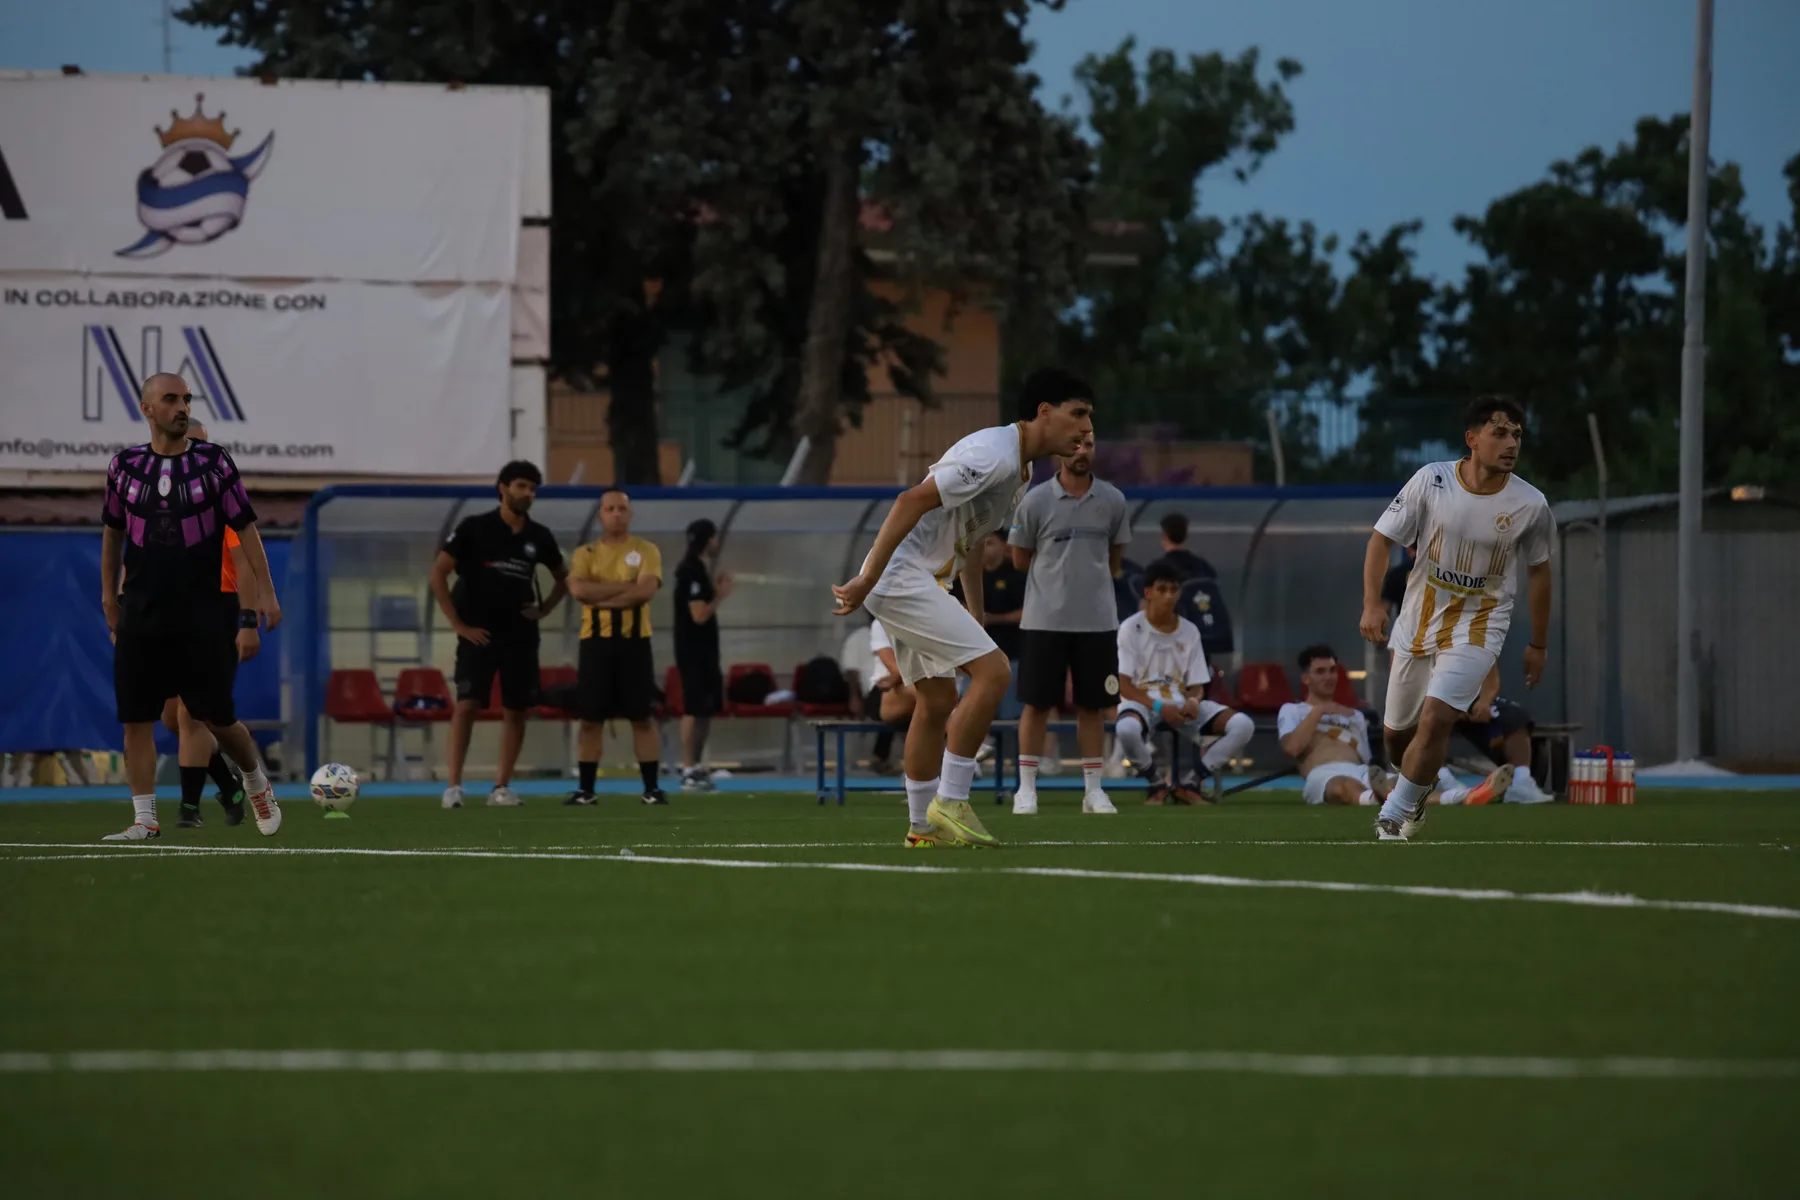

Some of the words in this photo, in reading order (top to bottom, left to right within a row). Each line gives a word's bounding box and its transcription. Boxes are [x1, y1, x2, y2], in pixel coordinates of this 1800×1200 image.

[5, 289, 29, 306] IN
[36, 289, 267, 311] COLLABORAZIONE
[273, 293, 327, 311] CON
